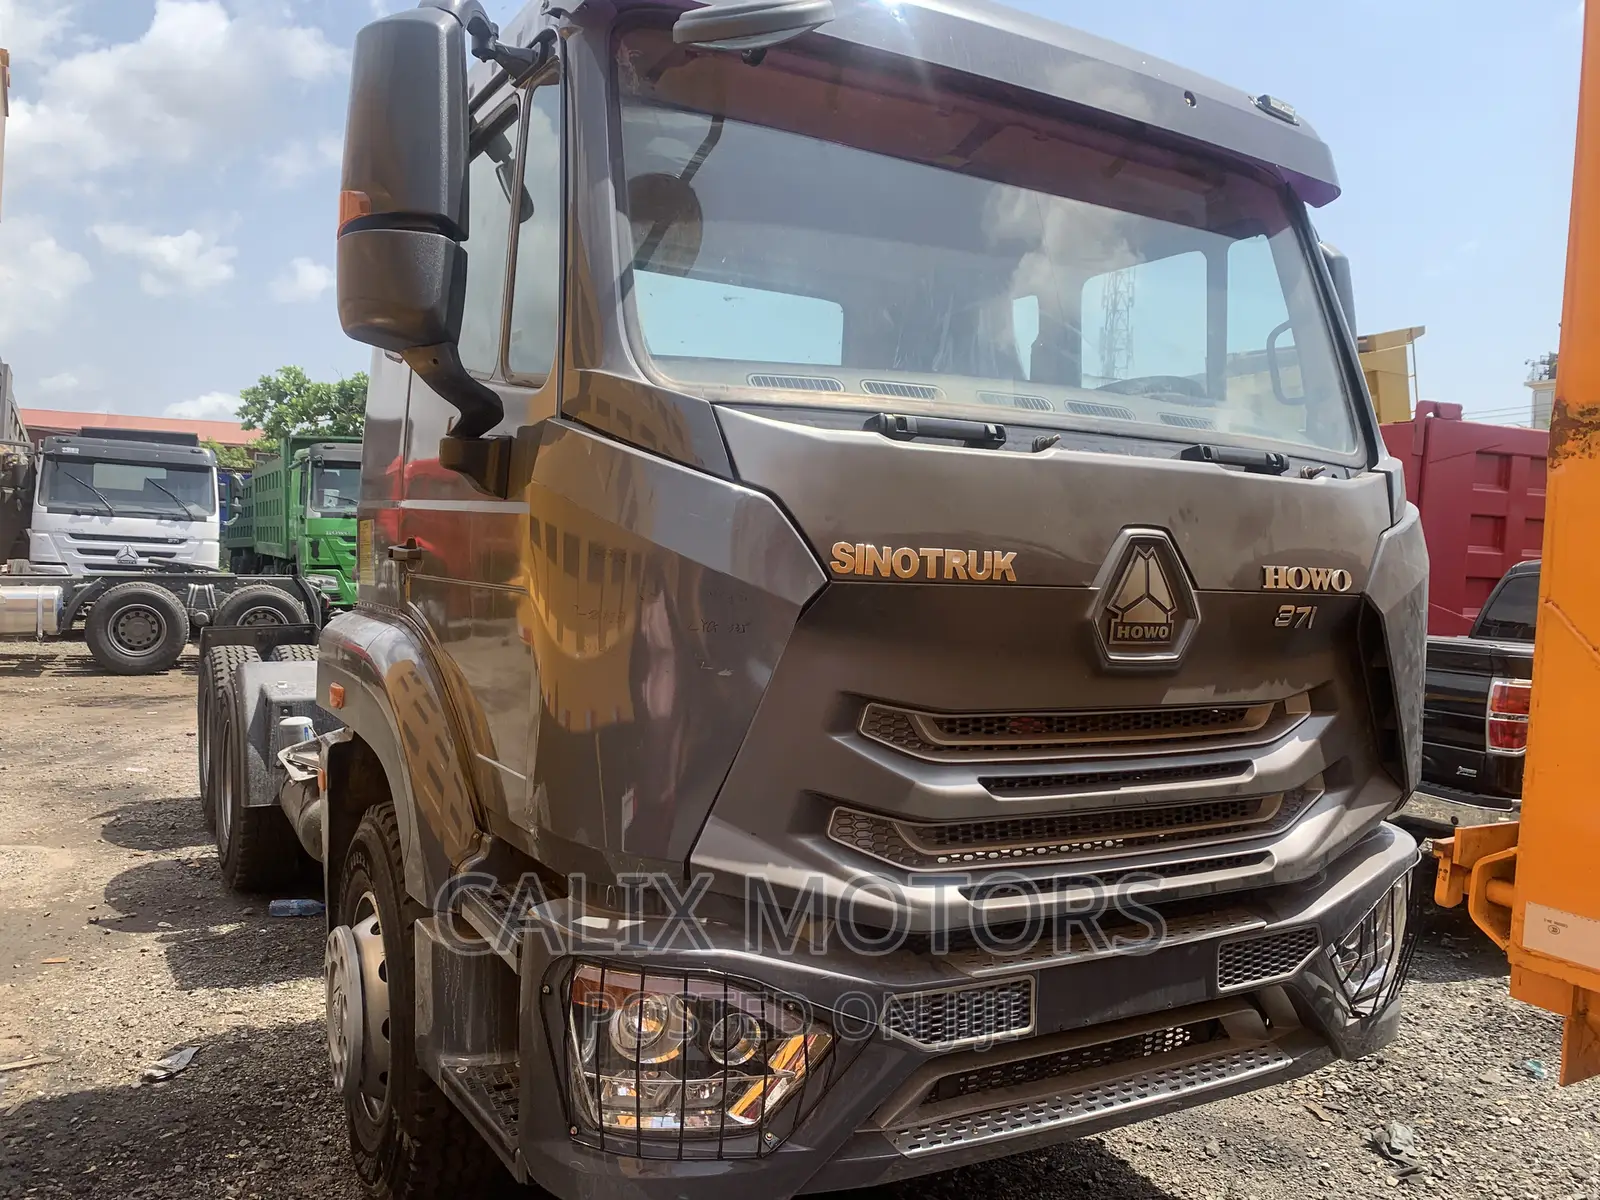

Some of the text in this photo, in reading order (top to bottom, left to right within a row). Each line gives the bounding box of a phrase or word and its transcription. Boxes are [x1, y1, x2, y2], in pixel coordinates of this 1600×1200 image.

[829, 541, 1018, 582] SINOTRUK
[1262, 564, 1353, 592] HOWO
[1274, 604, 1318, 629] 371
[1116, 625, 1169, 640] HOWO
